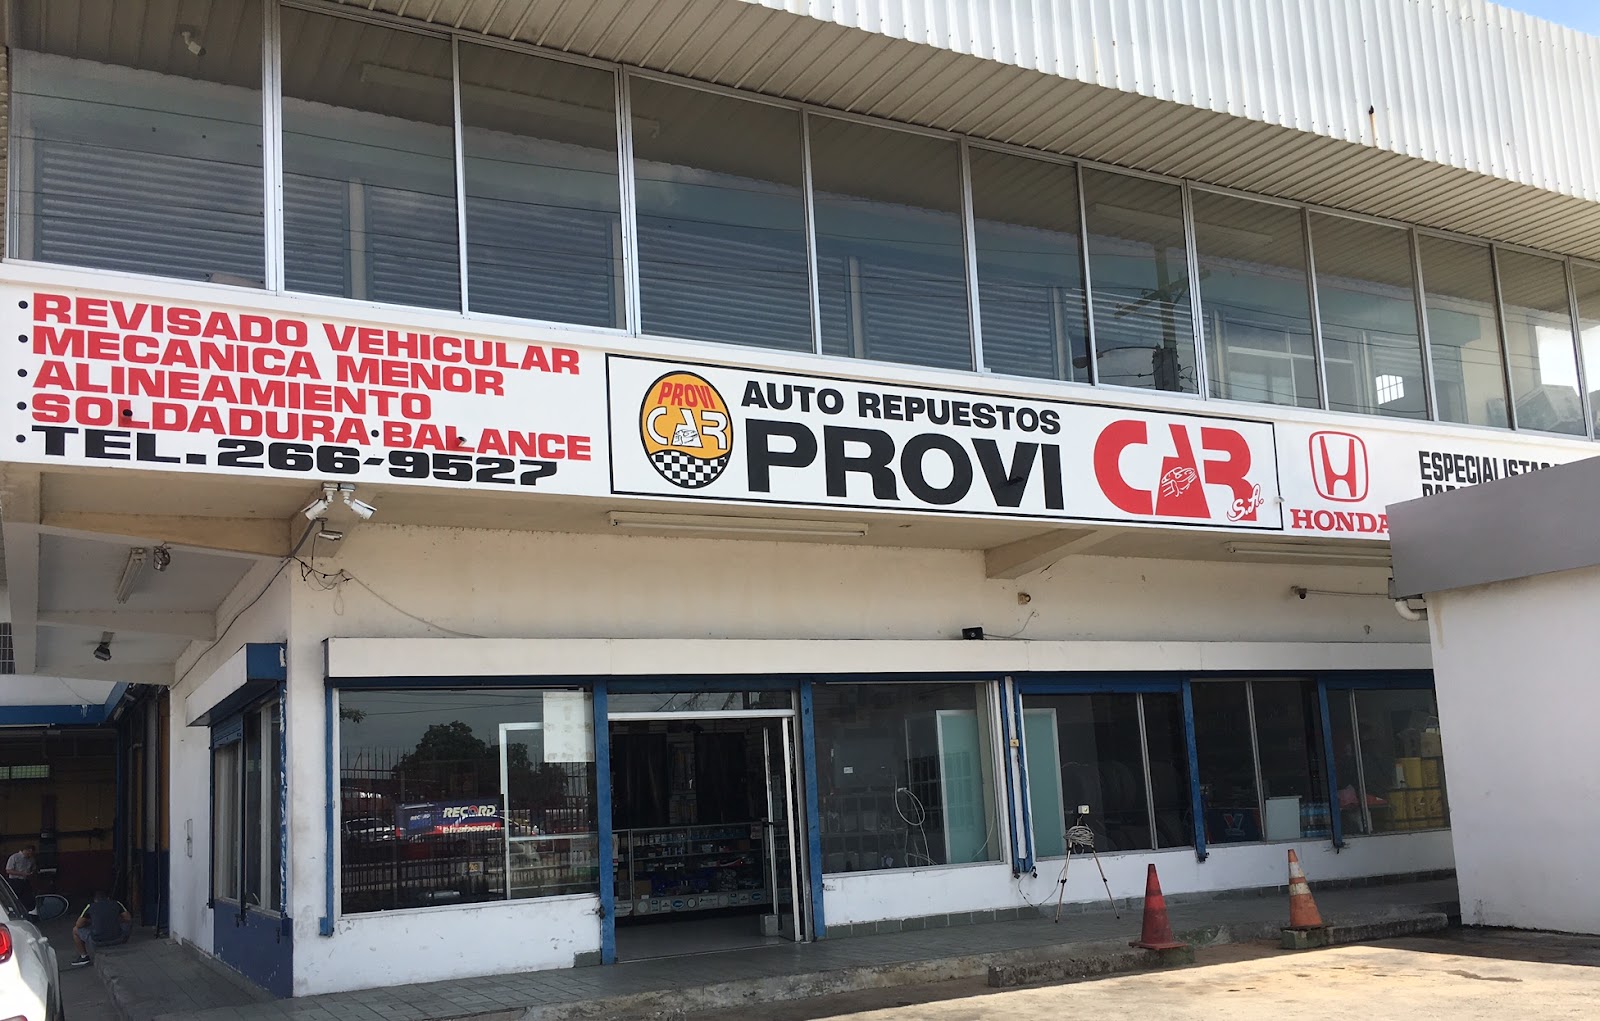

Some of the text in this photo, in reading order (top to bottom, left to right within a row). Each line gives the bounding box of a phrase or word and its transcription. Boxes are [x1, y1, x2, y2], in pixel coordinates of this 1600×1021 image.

[32, 325, 505, 397] MECANICA MENOR
[33, 292, 580, 375] REVISADO VEHICULAR
[33, 360, 432, 421] ALINEAMIENTO
[656, 381, 717, 410] PROVI
[740, 380, 1061, 435] AUTO REPUESTOS
[31, 425, 558, 486] TEL. 266-9527
[32, 393, 592, 462] SOLDADURA BALANCE
[645, 405, 728, 451] CAR
[745, 418, 1065, 510] PROVI
[1093, 419, 1255, 520] CAR
[1226, 483, 1265, 522] S.A.
[442, 805, 497, 818] RECORD
